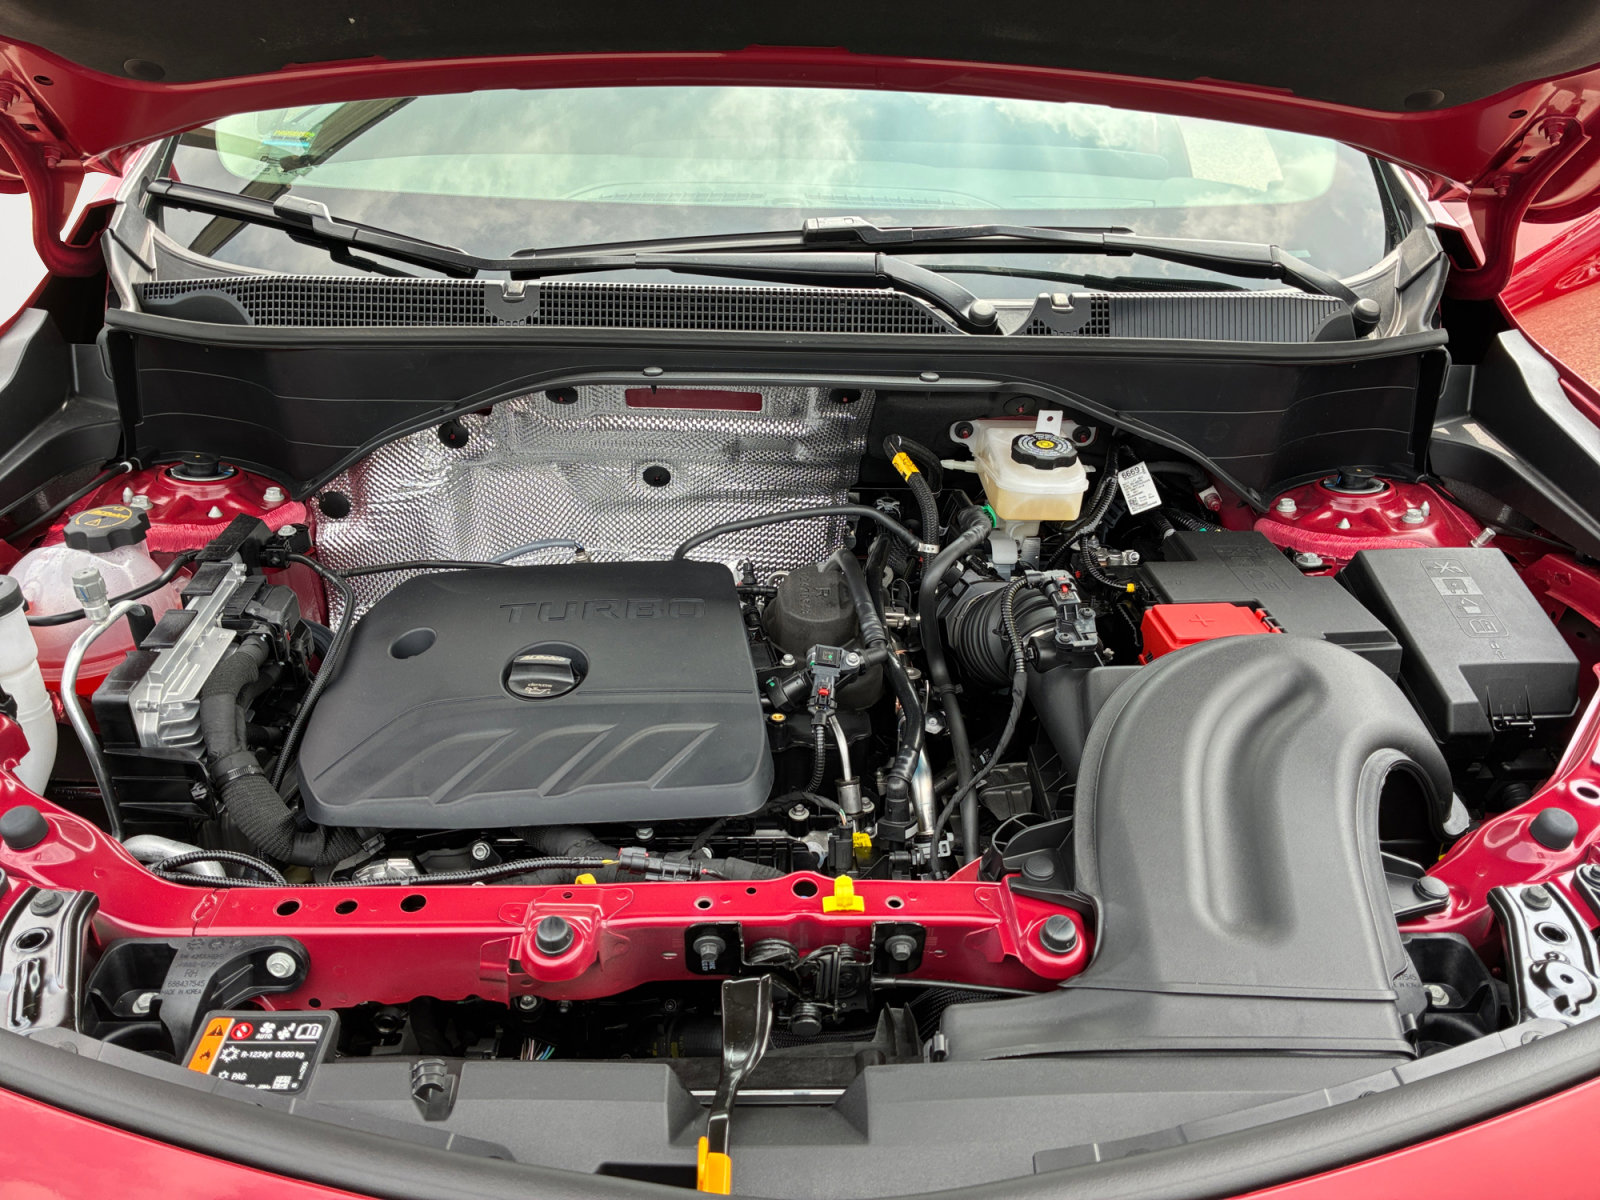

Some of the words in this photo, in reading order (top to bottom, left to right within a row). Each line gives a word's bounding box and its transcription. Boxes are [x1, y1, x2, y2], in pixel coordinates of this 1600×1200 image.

[1121, 466, 1140, 479] 6669
[499, 597, 706, 624] TURBO
[184, 968, 200, 978] RH
[240, 1050, 273, 1060] R-1234yf
[274, 1050, 294, 1058] 0.600
[295, 1051, 305, 1060] kg
[230, 1072, 248, 1081] PAG
